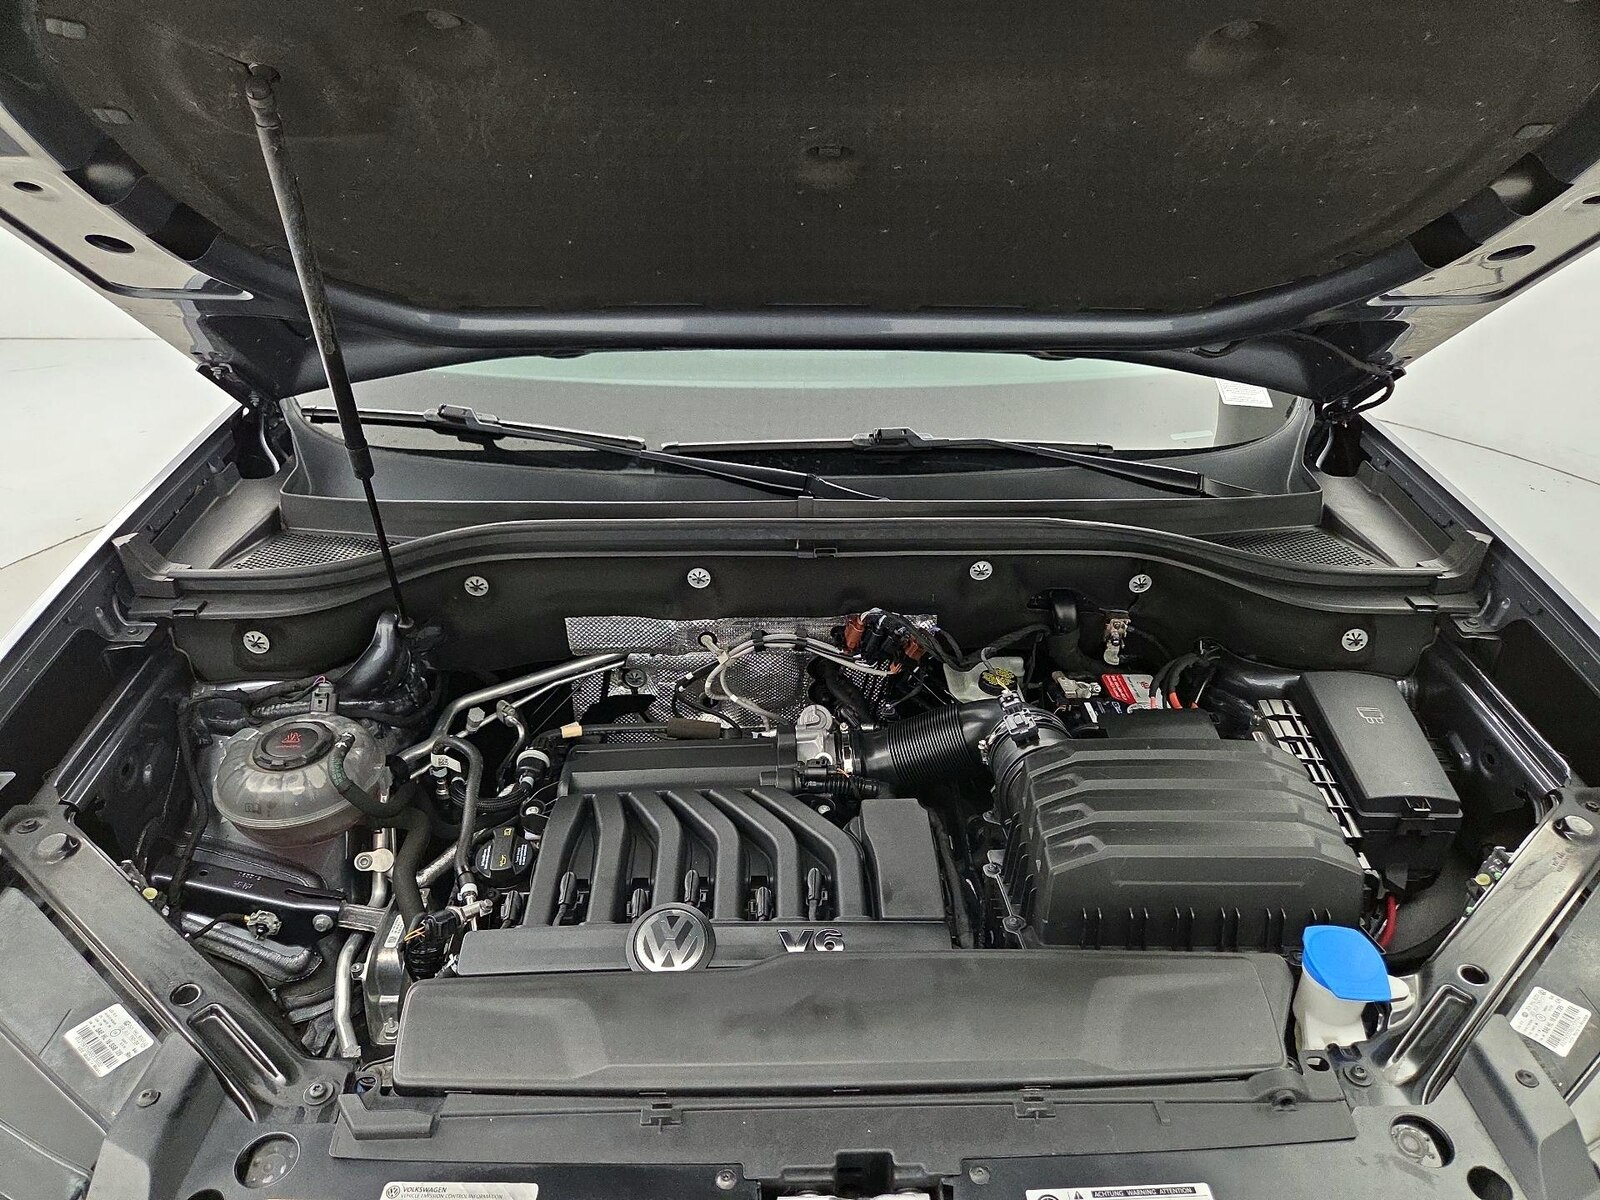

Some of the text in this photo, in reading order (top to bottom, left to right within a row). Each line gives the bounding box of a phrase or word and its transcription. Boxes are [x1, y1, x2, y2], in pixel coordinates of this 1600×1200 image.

[777, 929, 845, 952] V6
[1094, 1190, 1124, 1198] ACHTUNG
[1126, 1188, 1157, 1196] WARNING
